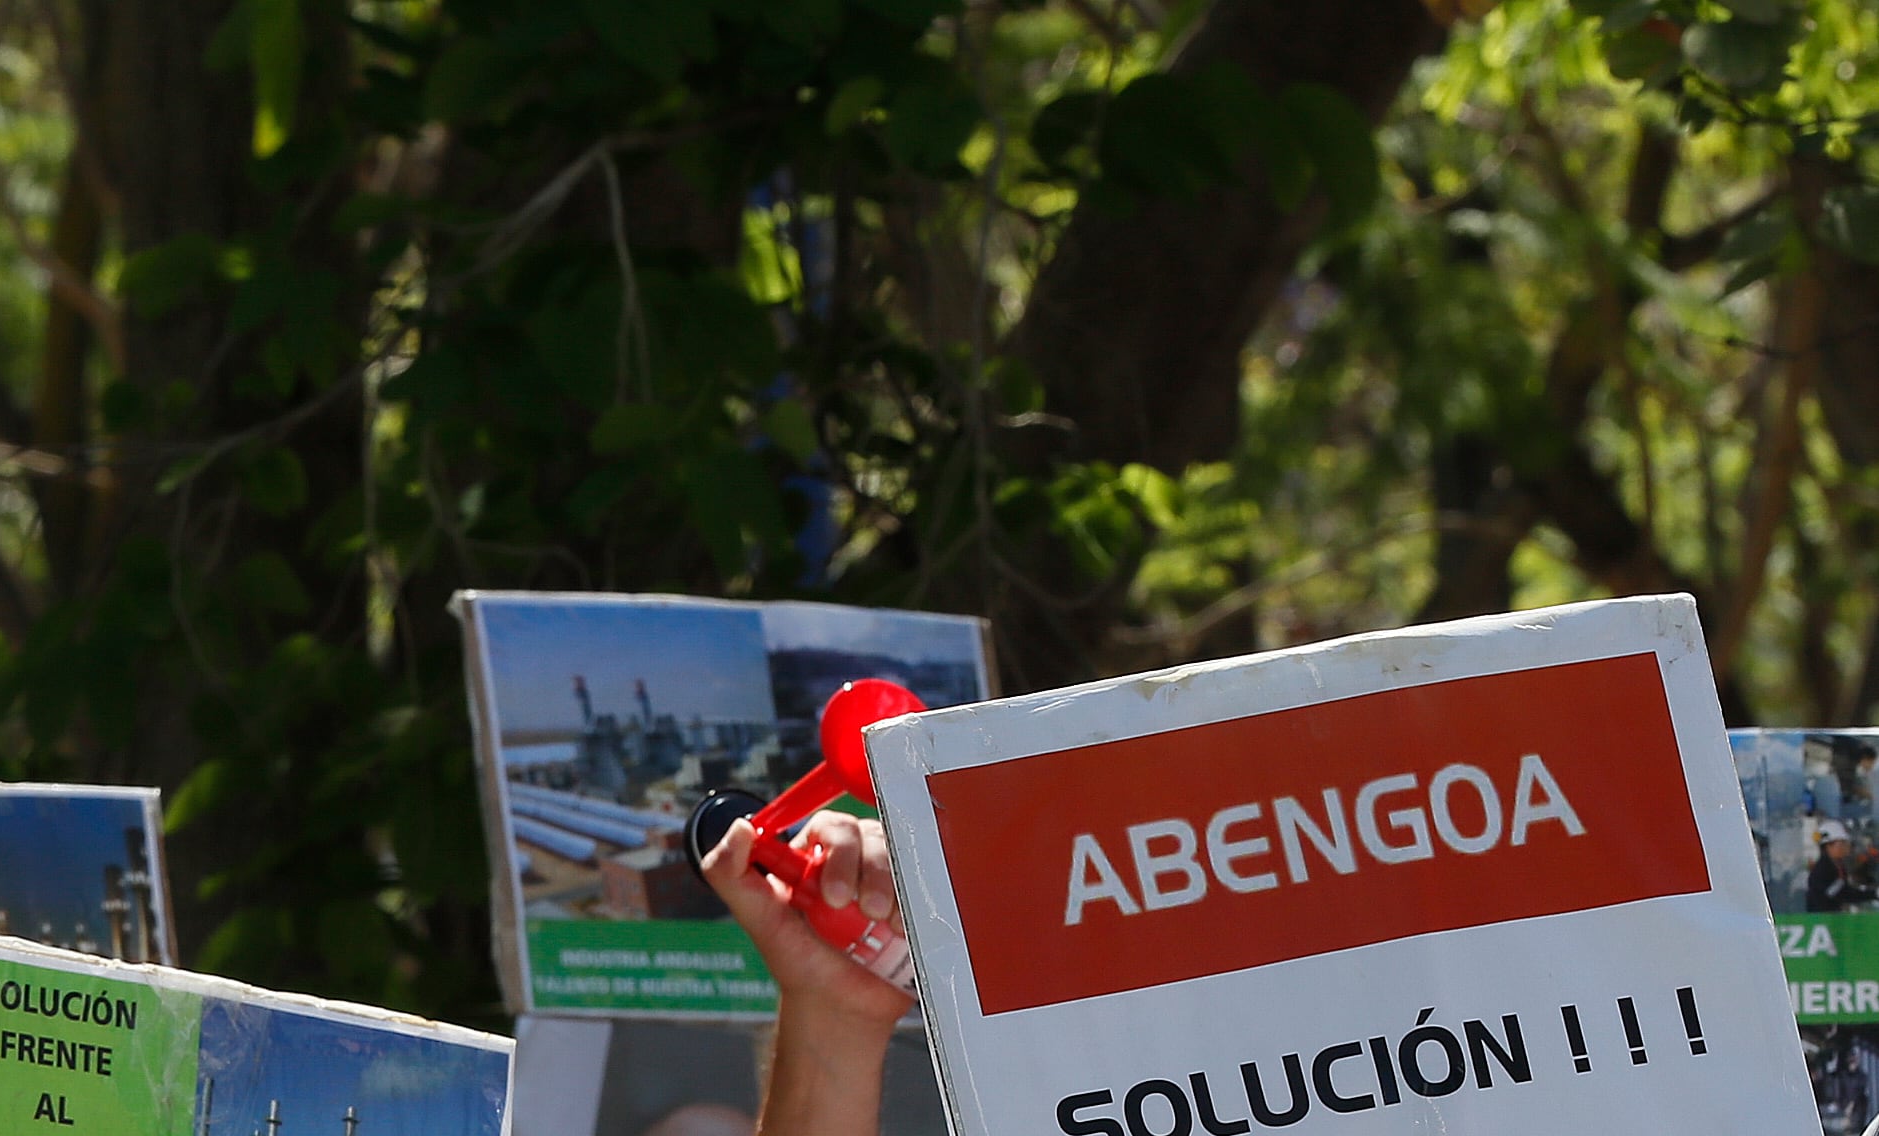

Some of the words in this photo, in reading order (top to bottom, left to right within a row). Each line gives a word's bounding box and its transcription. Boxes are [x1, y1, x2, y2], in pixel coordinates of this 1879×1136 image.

[1064, 754, 1586, 926] ABENGOA
[0, 1031, 112, 1076] FRENTE
[34, 1093, 74, 1125] AL
